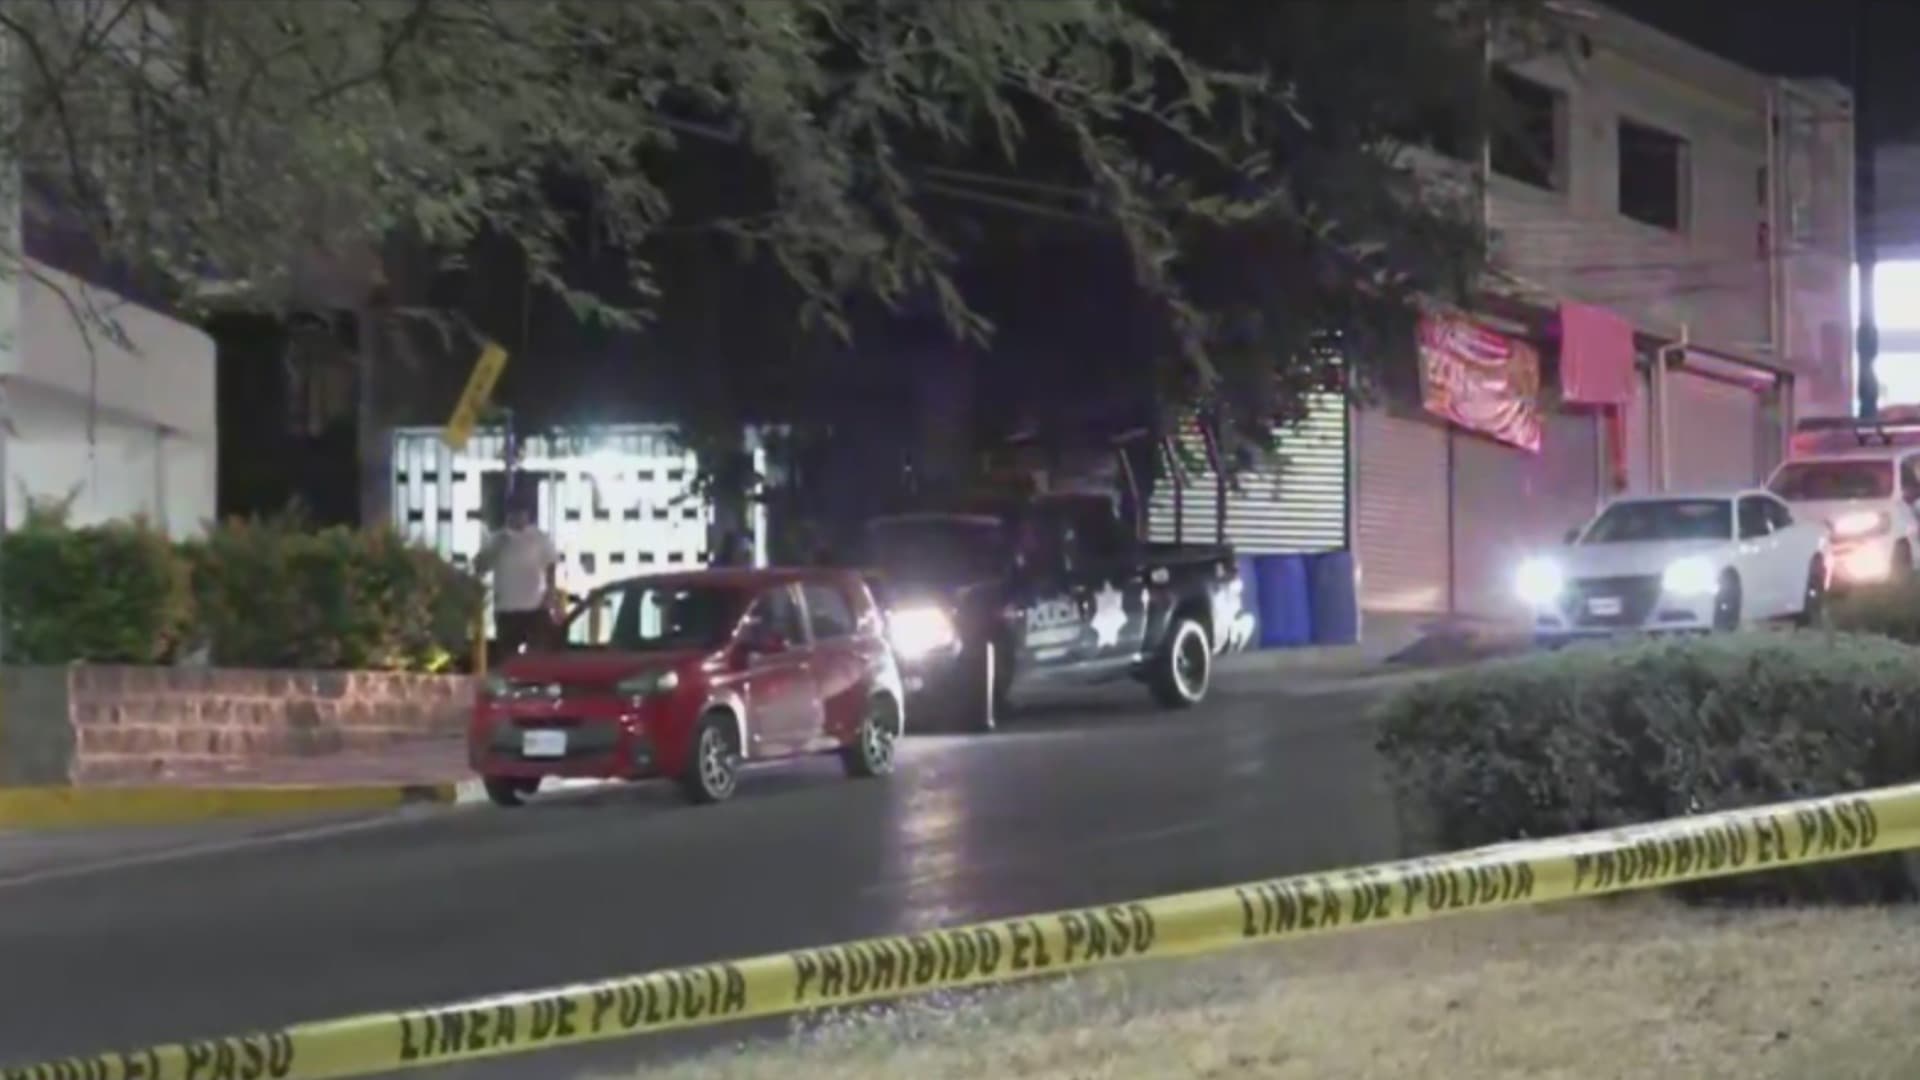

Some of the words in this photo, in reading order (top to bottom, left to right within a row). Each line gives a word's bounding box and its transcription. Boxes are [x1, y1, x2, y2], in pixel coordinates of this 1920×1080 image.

[1572, 819, 1747, 891] PROHIBIDO
[1753, 815, 1787, 862] EL
[1796, 799, 1877, 858] PASO
[1237, 881, 1341, 937] LINEA
[1350, 872, 1391, 923] DE
[1403, 860, 1535, 915] POLICIA
[793, 928, 1001, 1001] PROHIBIDO
[1007, 921, 1052, 970] EL
[1059, 904, 1155, 964] PASO
[184, 1034, 293, 1080] PASO
[400, 1004, 516, 1060] LINEA
[530, 996, 577, 1040] DE
[592, 965, 746, 1032] POLICIA
